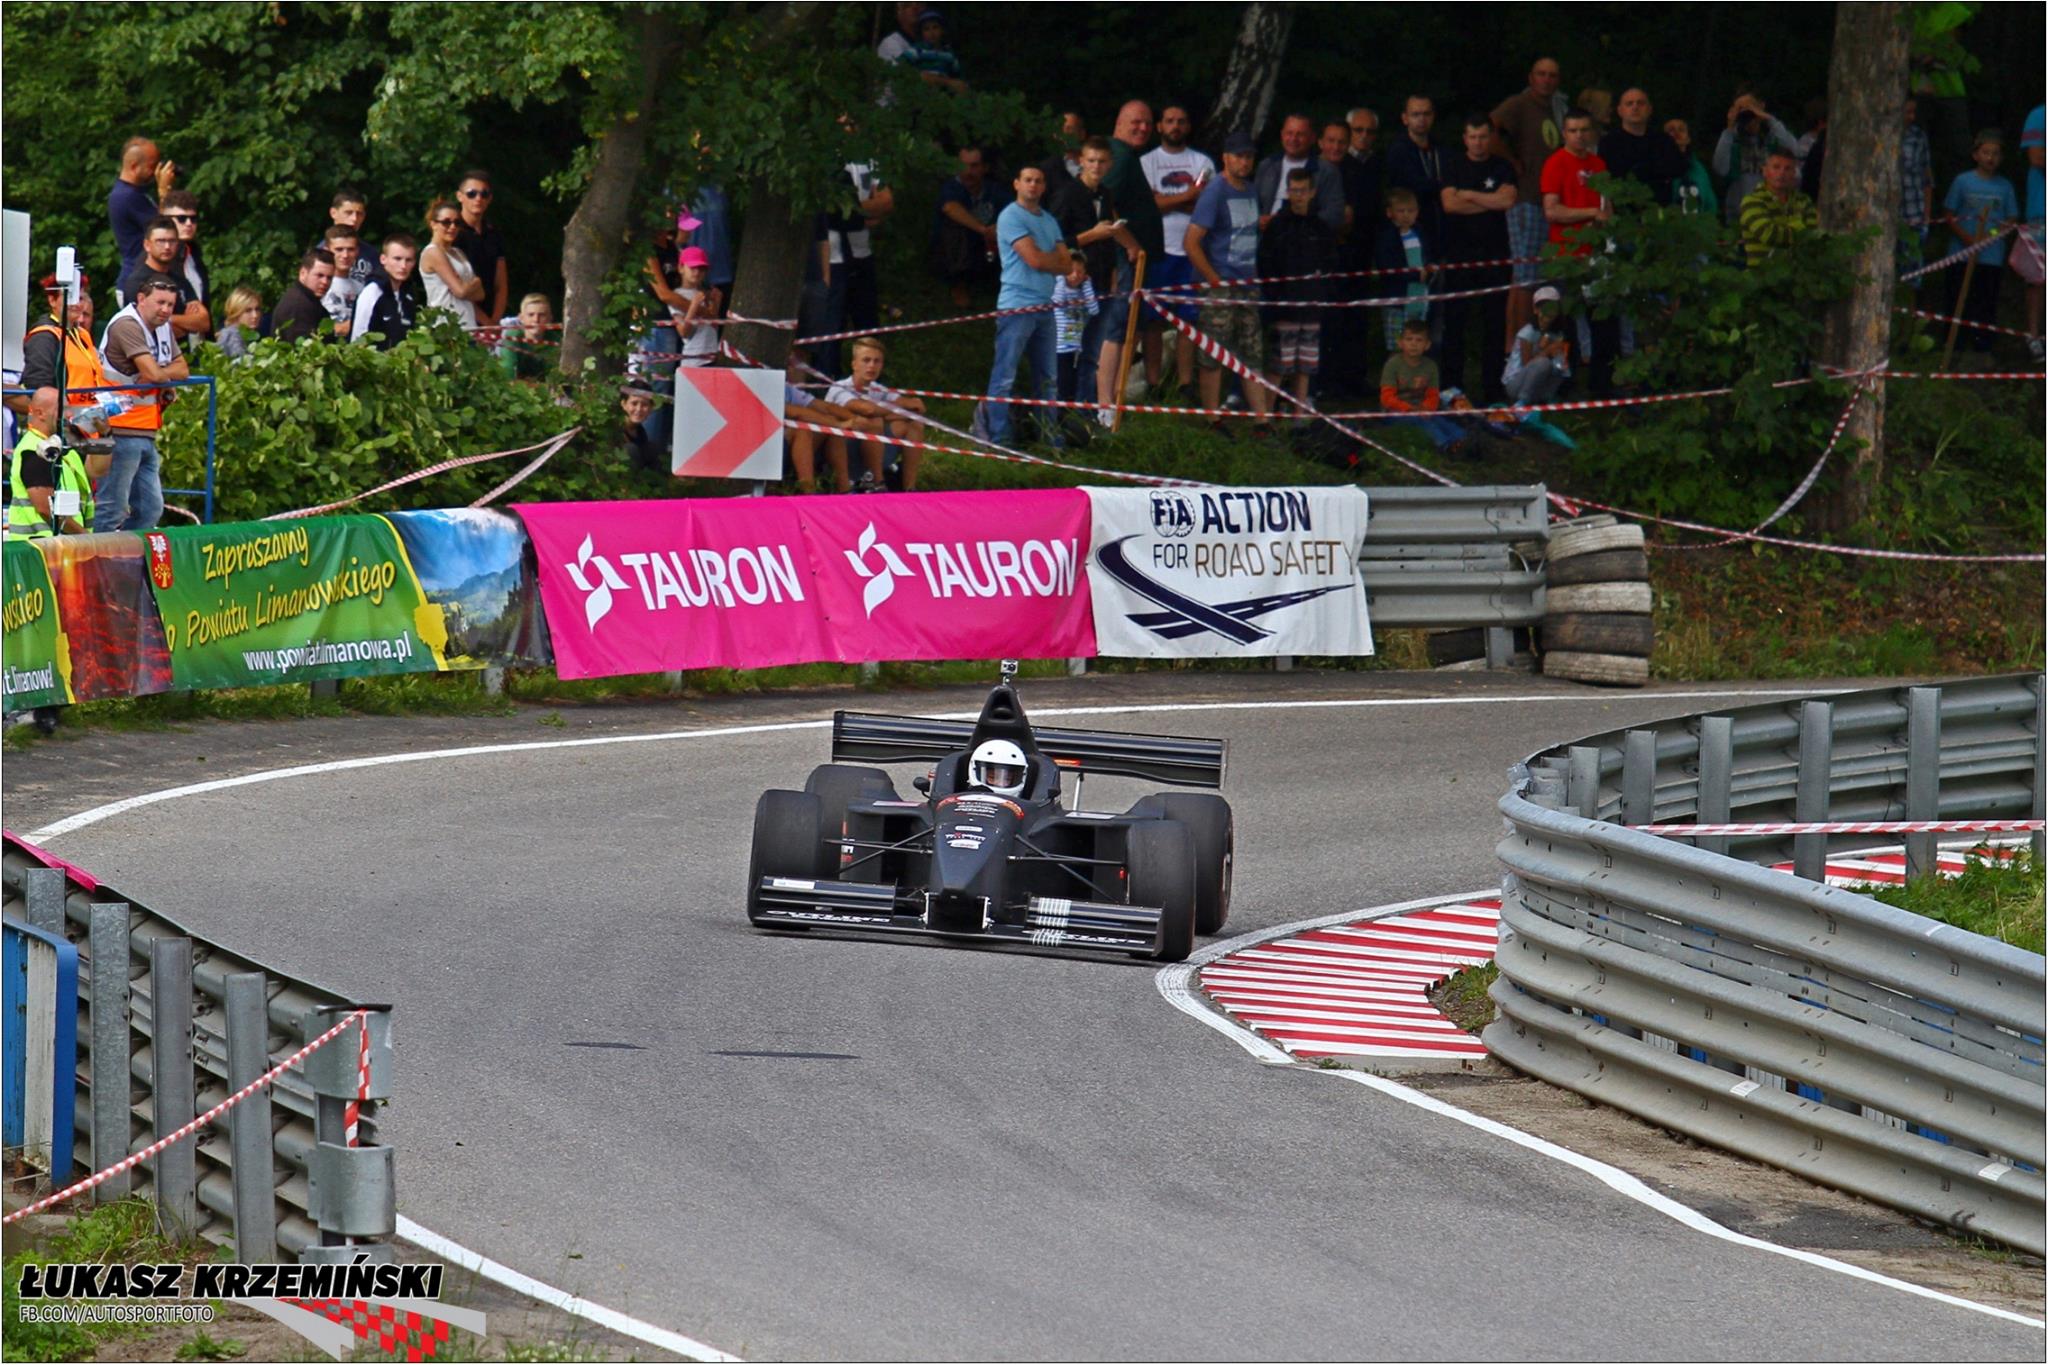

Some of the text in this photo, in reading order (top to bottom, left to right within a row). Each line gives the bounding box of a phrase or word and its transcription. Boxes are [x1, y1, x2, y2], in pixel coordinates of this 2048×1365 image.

[1202, 490, 1312, 534] ACTION
[202, 527, 309, 590] Zapraszamy
[619, 545, 805, 611] TAURON
[905, 538, 1078, 597] TAURON
[1152, 540, 1356, 578] FOR ROAD SAFETY
[186, 600, 249, 647] Powiatu
